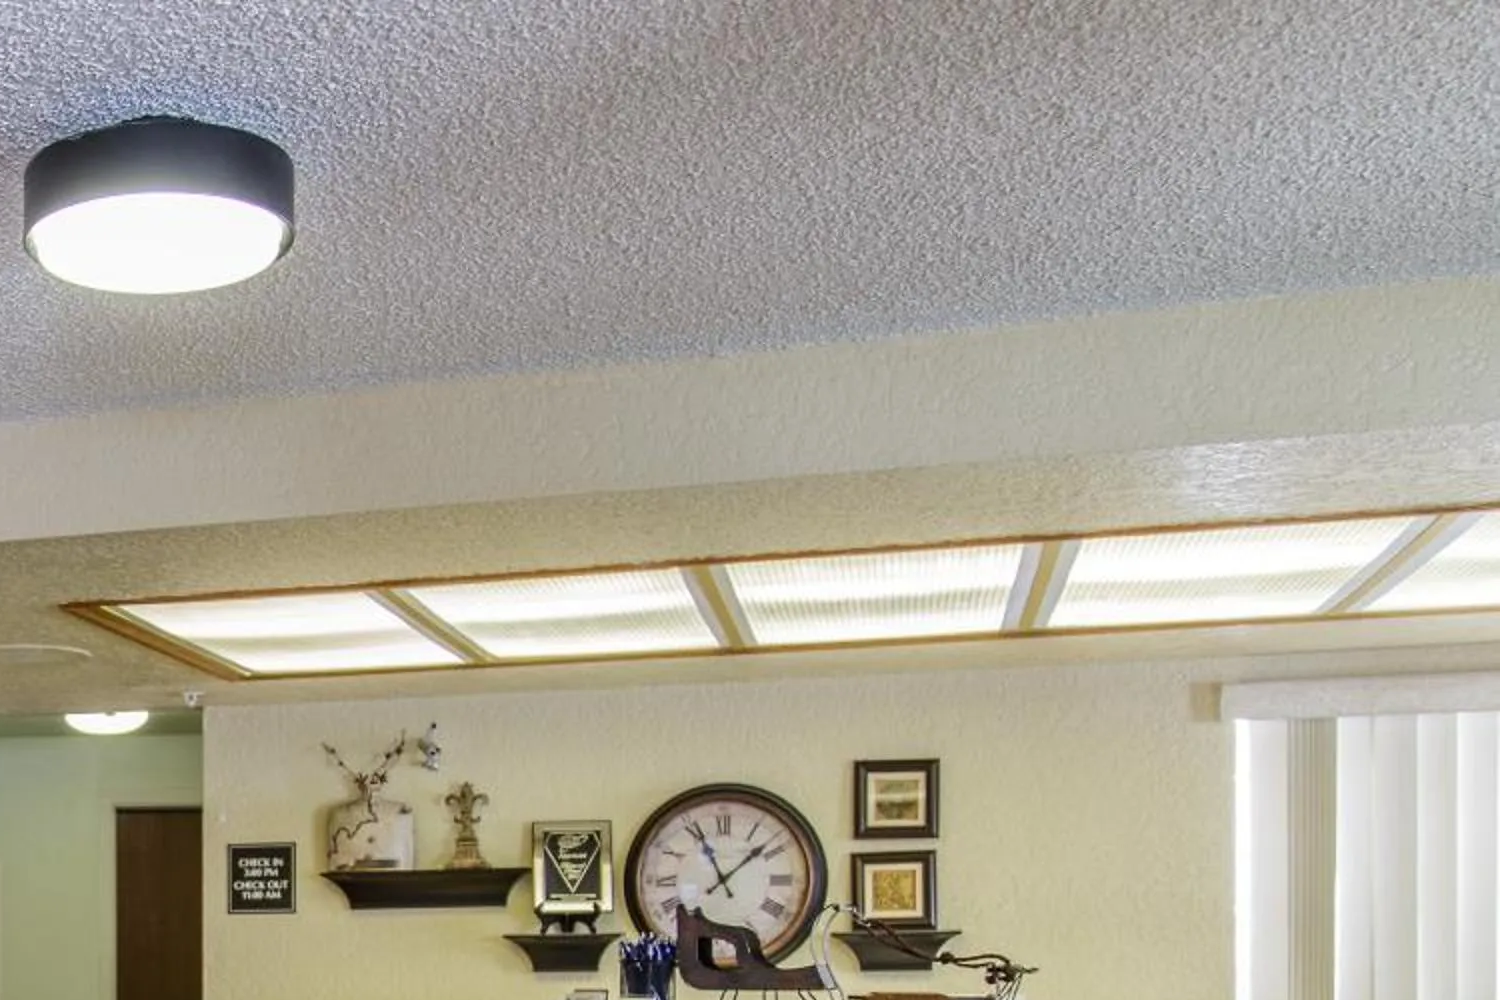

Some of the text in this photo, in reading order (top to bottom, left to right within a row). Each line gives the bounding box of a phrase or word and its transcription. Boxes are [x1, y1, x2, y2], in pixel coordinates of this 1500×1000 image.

[238, 857, 270, 868] CHECK
[233, 880, 288, 891] CHECK OUT
